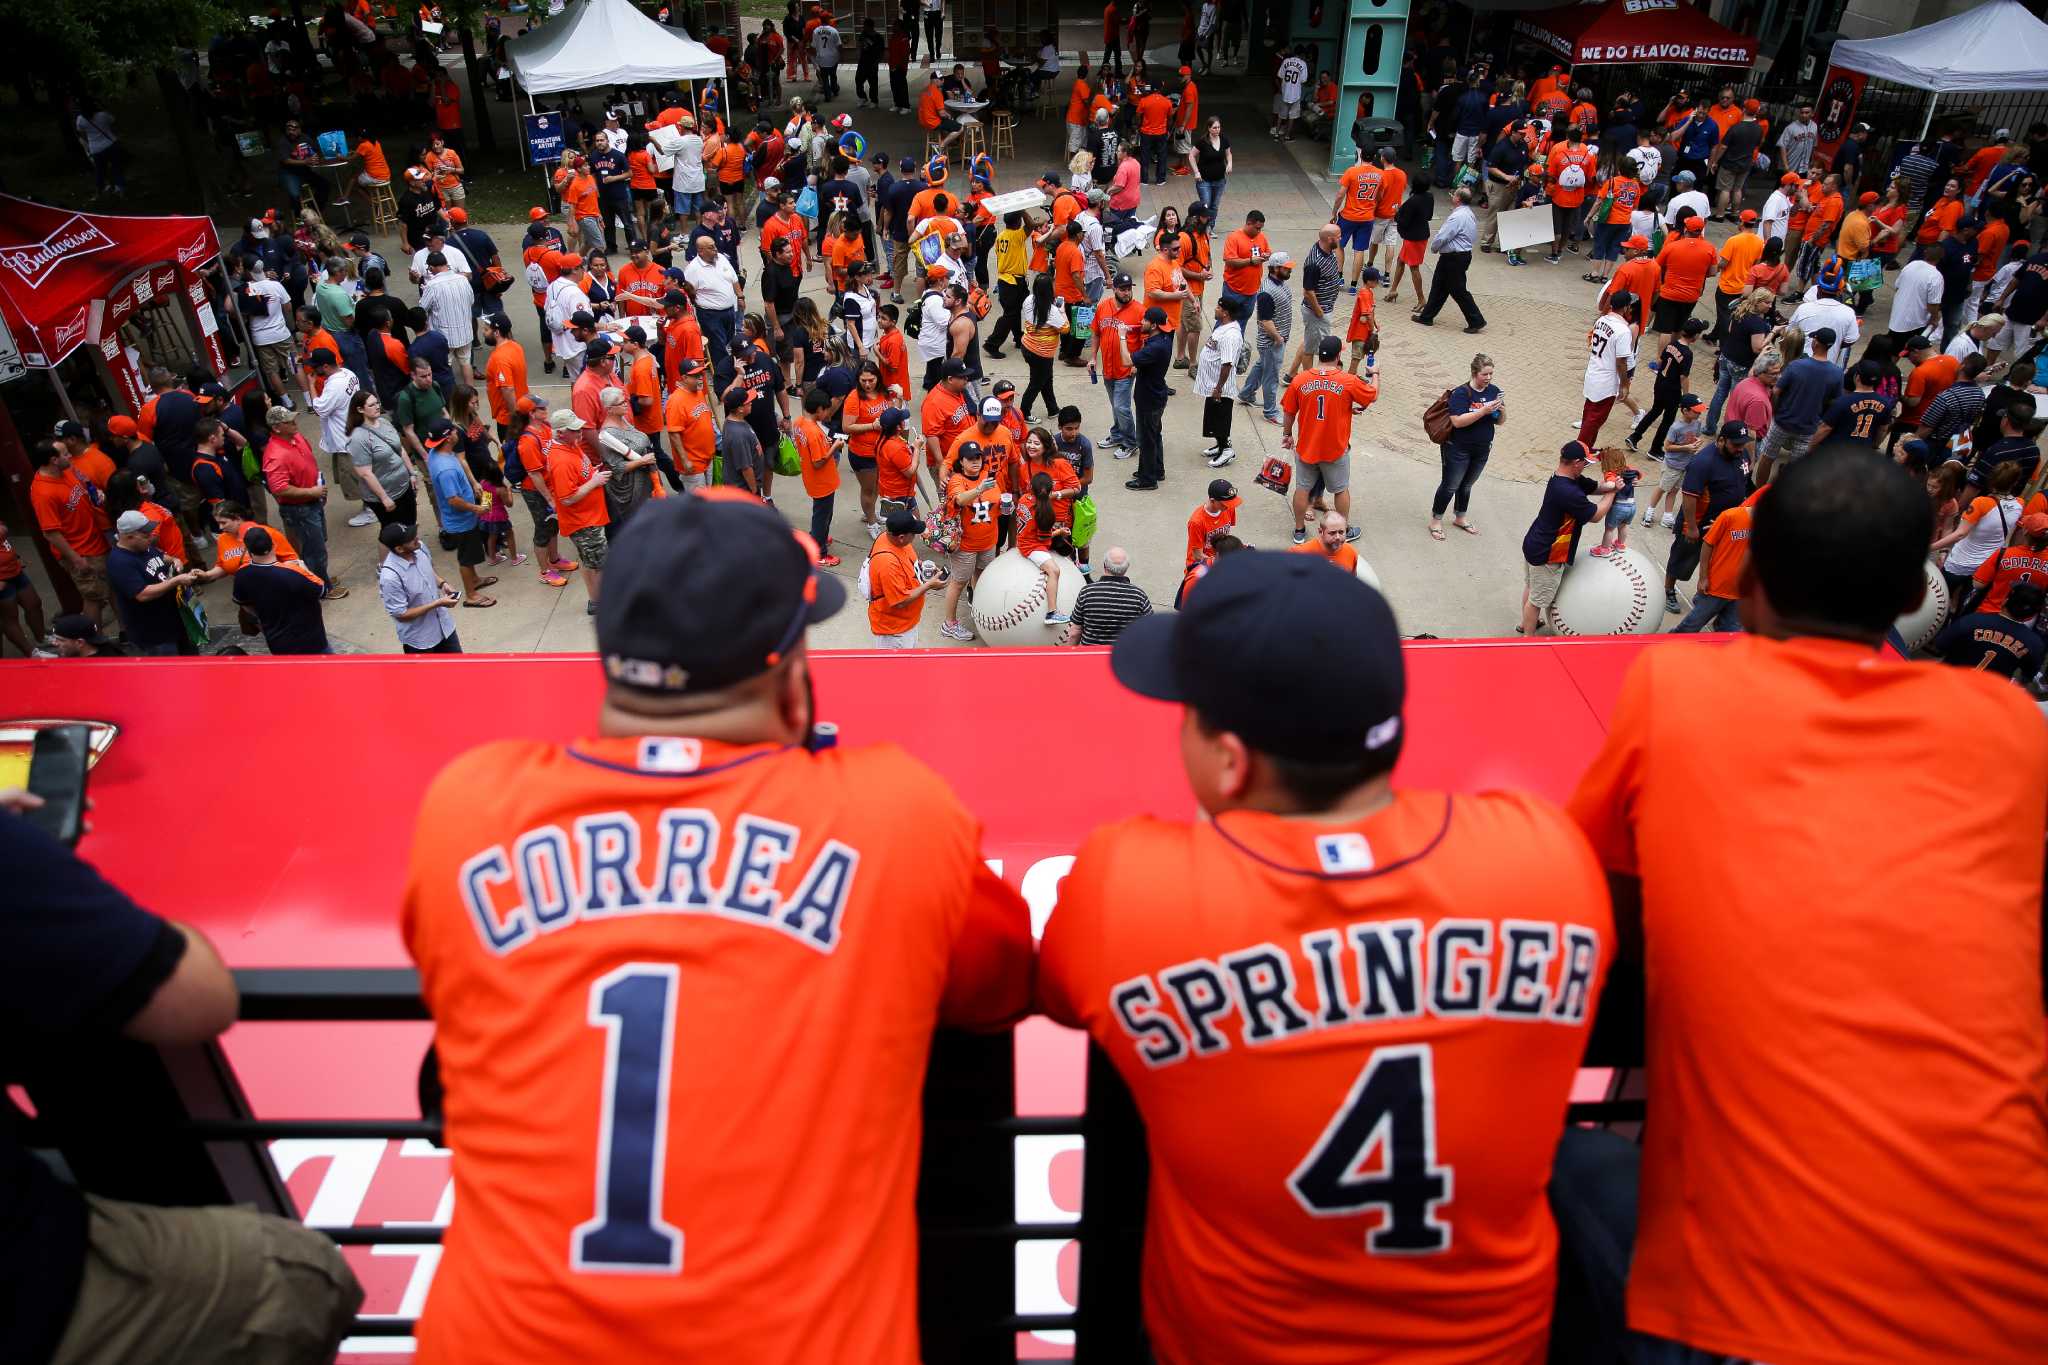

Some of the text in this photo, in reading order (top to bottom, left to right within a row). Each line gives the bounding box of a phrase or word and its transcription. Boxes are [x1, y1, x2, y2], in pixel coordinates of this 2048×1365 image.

[821, 36, 829, 48] 7
[1581, 44, 1750, 62] WE DO FLAVOR BIGGER.
[1285, 70, 1299, 84] 60
[1357, 182, 1377, 200] 27
[833, 196, 848, 211] H
[2, 227, 99, 275] Budweiser
[1252, 246, 1260, 257] H
[1592, 333, 1608, 358] 27
[1662, 357, 1673, 377] 1
[1301, 379, 1344, 395] CORREA
[1316, 395, 1325, 420] 1
[1850, 400, 1885, 413] GATTIS
[1850, 414, 1874, 438] 11
[971, 502, 991, 522] H
[1975, 650, 1997, 673] 1
[459, 807, 860, 956] CORREA
[1108, 918, 1598, 1069] SPRINGER
[569, 961, 685, 1275] 1
[1285, 1042, 1453, 1255] 4
